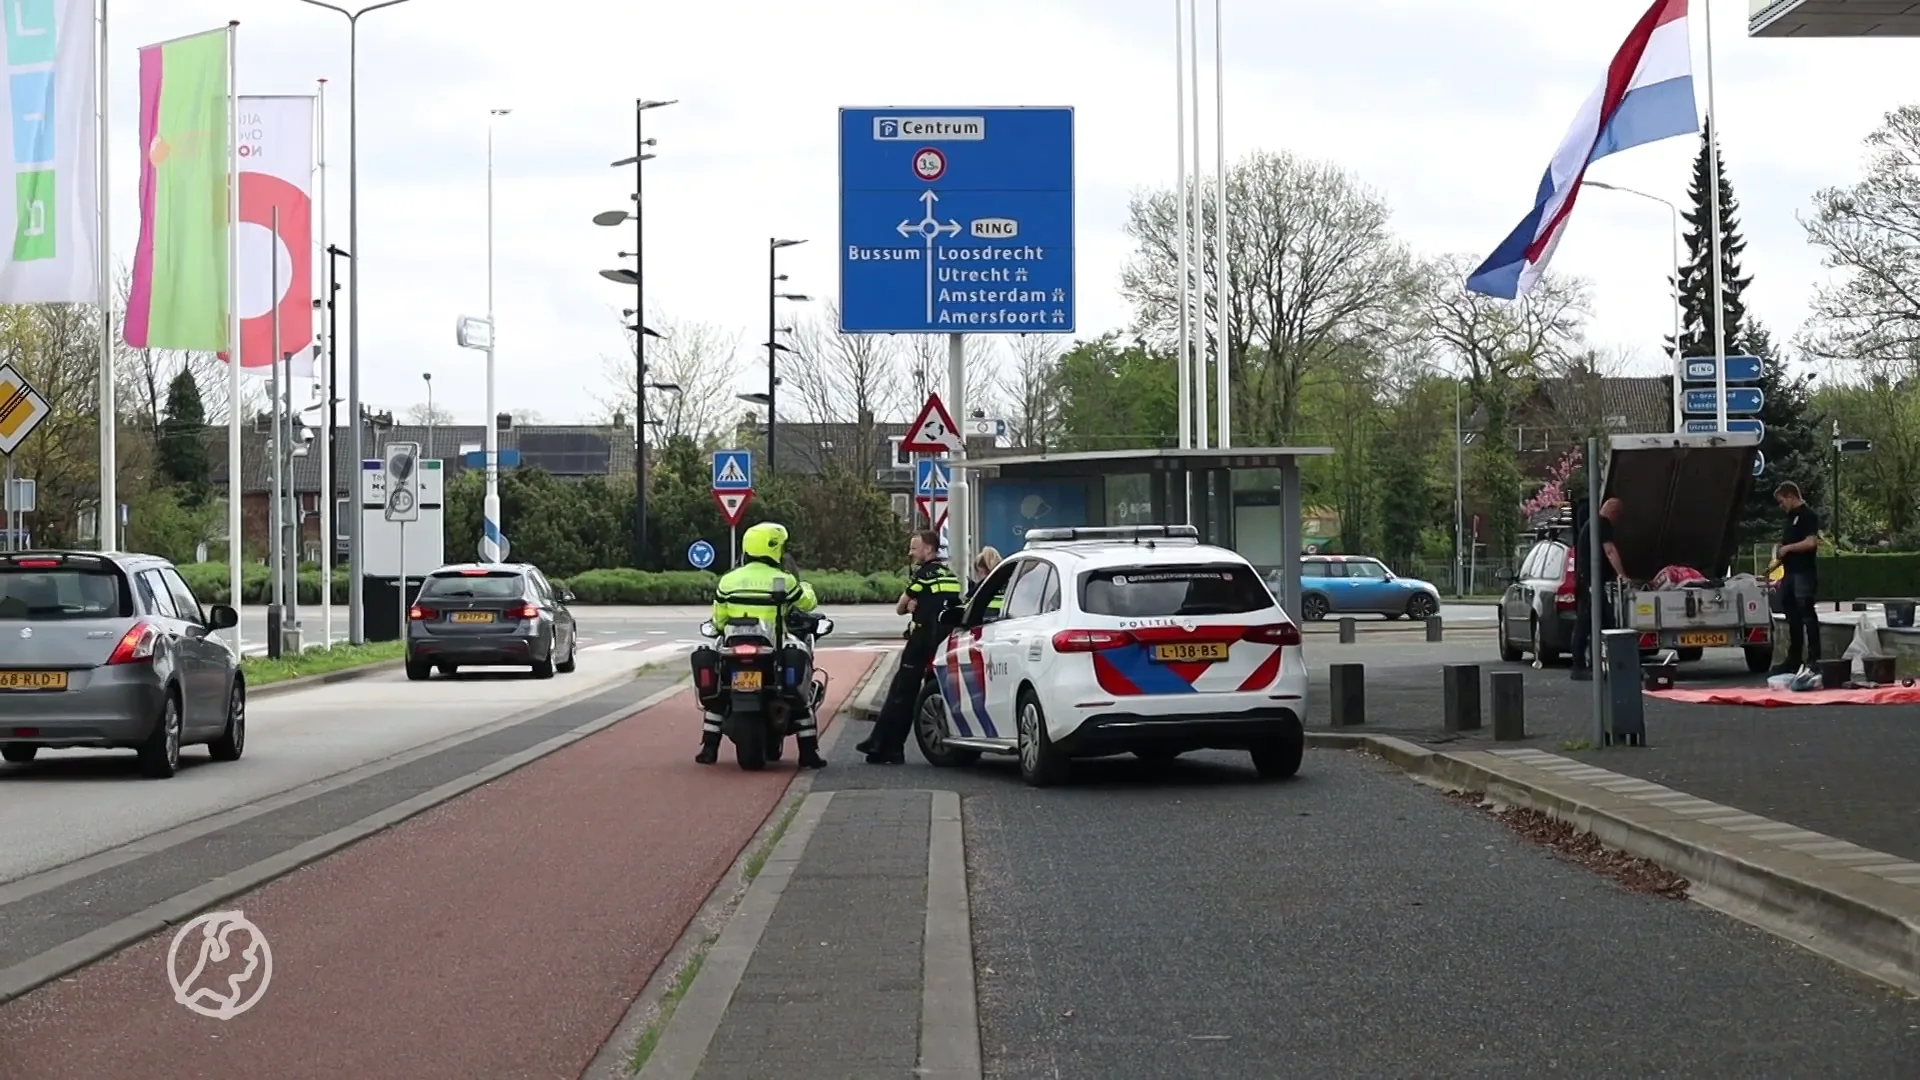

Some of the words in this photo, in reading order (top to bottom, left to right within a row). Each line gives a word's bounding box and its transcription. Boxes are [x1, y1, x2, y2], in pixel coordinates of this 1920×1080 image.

[902, 121, 978, 134] Centrum
[975, 222, 1013, 234] RING
[849, 246, 921, 260] Bussum
[938, 246, 1043, 260] Loosdrecht
[938, 267, 1010, 282] Utrecht
[938, 288, 1046, 302] Amsterdam
[938, 309, 1046, 324] Amersfoort
[1119, 619, 1177, 628] POLITIE
[1161, 645, 1218, 658] L-138-BS
[0, 673, 62, 686] 68-RLD-1
